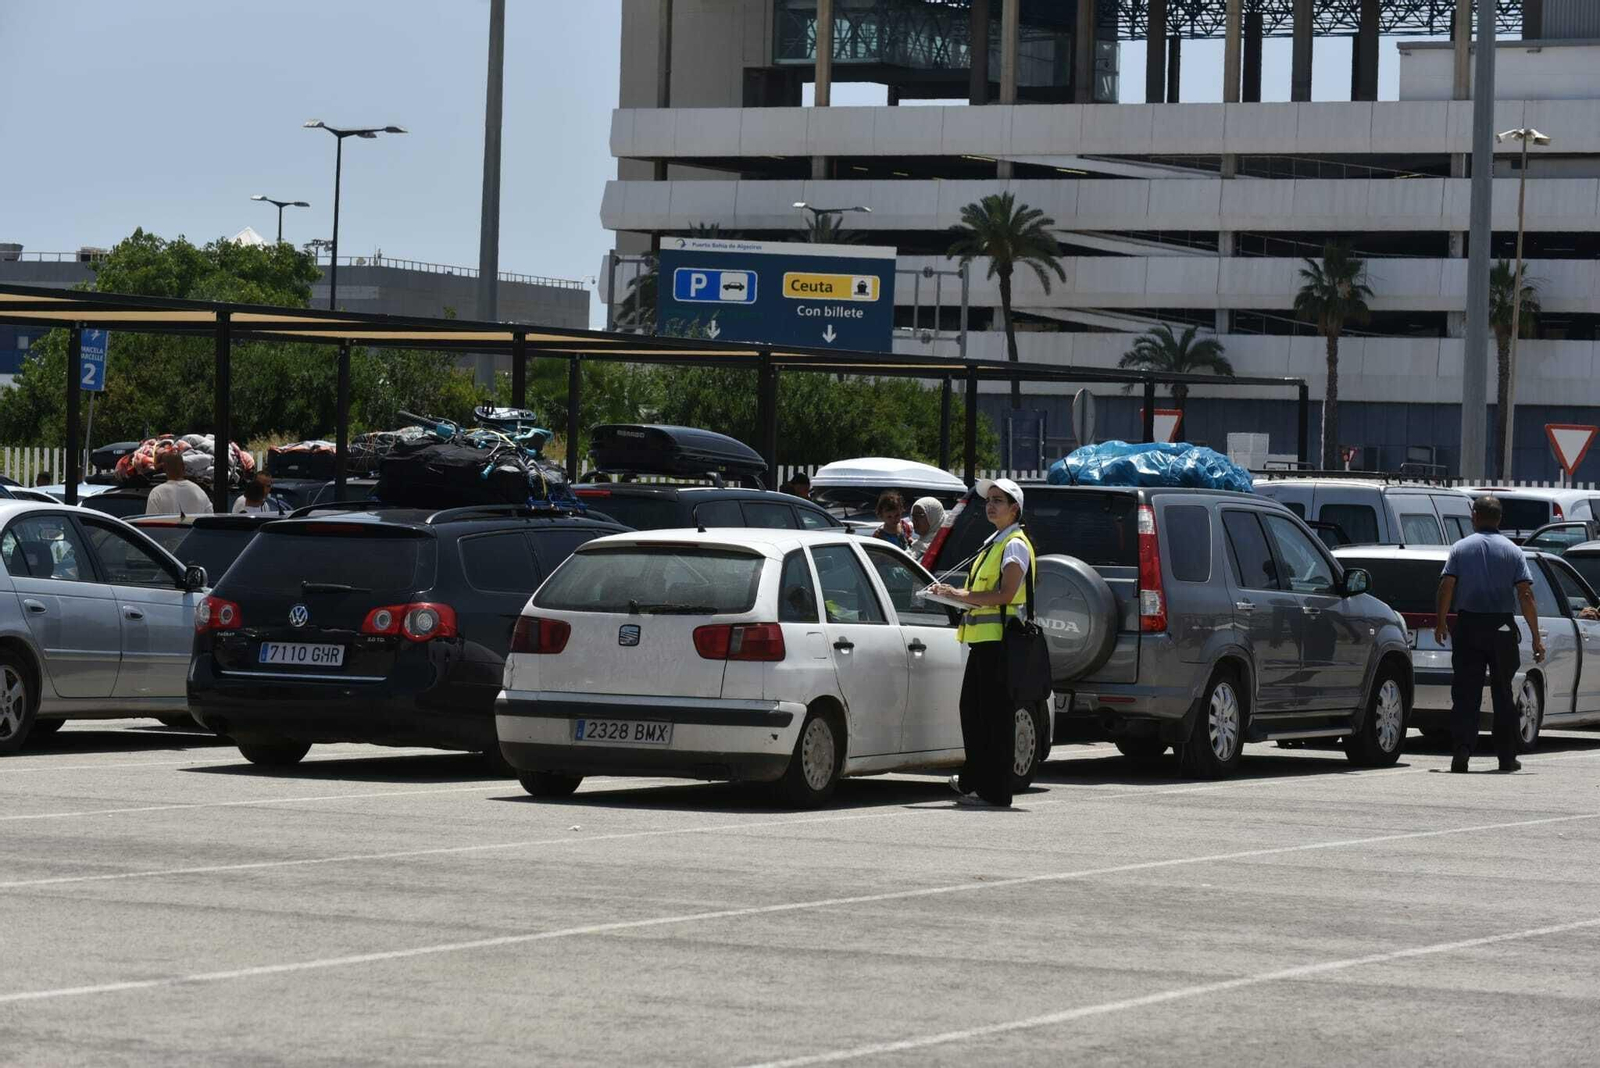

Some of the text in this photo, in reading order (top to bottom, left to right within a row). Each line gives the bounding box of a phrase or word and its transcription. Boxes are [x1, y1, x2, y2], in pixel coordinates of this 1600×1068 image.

[690, 273, 707, 297] P
[791, 279, 833, 293] Ceuta
[797, 305, 864, 318] Con billete
[82, 363, 96, 385] 2
[1035, 616, 1080, 633] NDA
[269, 646, 341, 664] 7110 GHR
[587, 722, 669, 742] 2328 BMX
